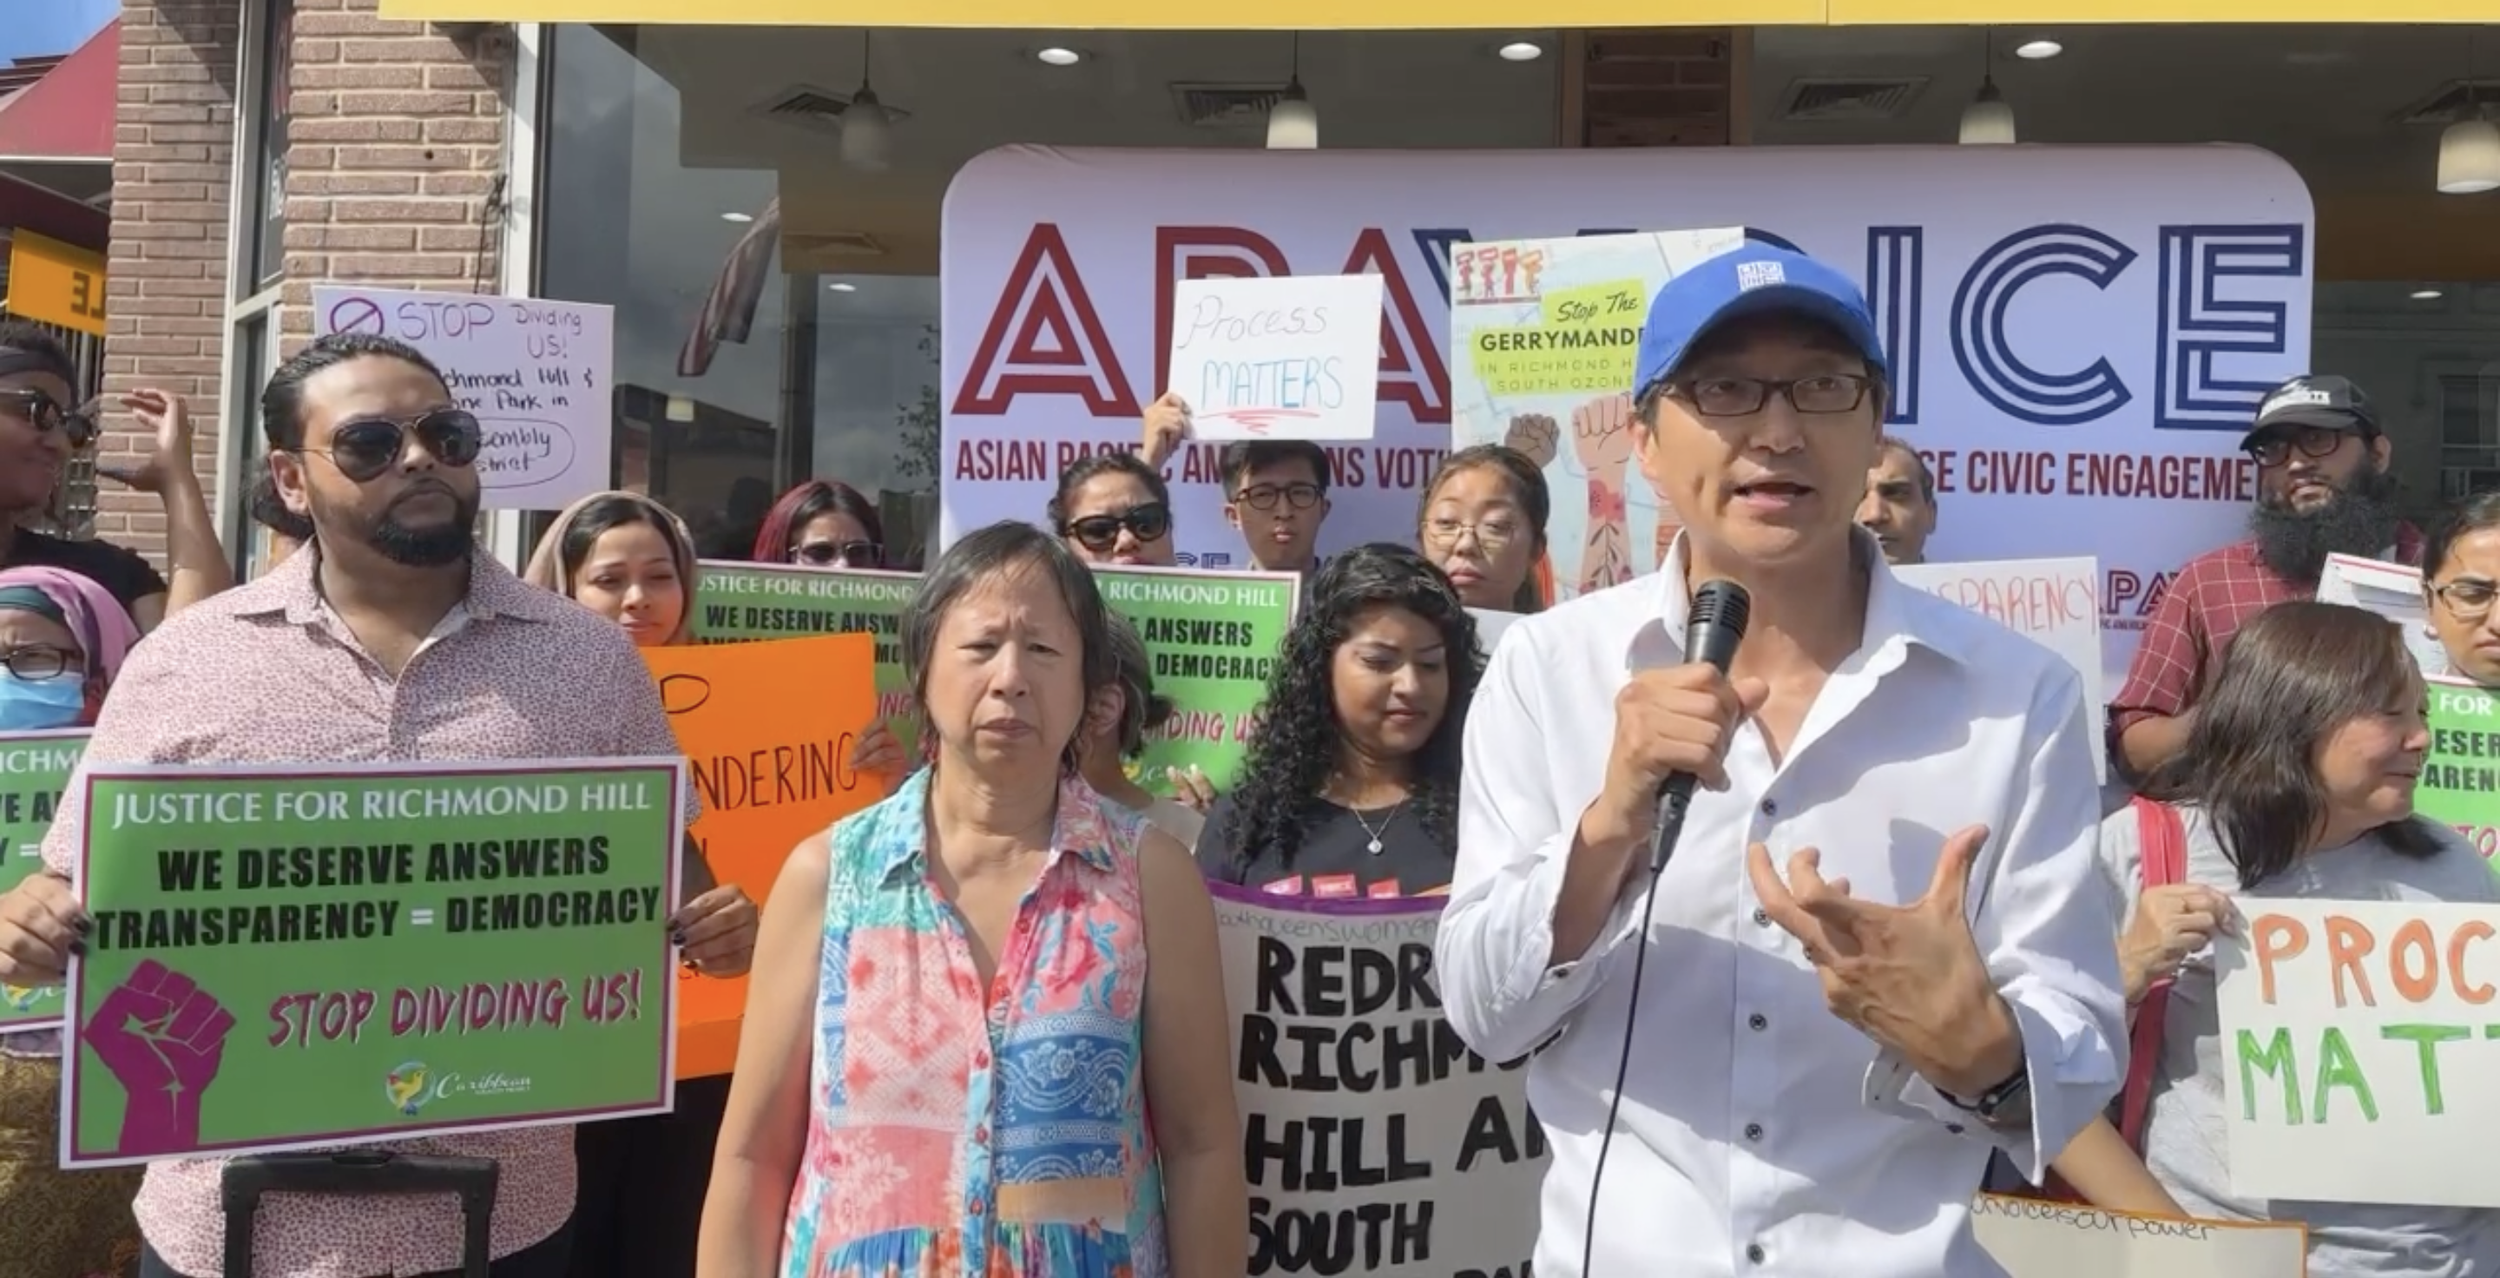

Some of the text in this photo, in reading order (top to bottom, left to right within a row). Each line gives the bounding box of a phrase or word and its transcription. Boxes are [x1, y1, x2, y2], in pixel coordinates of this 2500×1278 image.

[397, 301, 581, 341] STOP Dividing
[1176, 294, 1327, 349] Process
[1556, 290, 1638, 323] Stop The
[527, 333, 568, 360] US!
[1480, 327, 1644, 350] GERRYMAND
[442, 368, 523, 389] chmond
[1201, 355, 1342, 409] MATTERS
[1509, 359, 1610, 373] RICHMOND
[496, 389, 542, 410] Park
[552, 397, 568, 406] in
[1498, 379, 1559, 391] SOUTH
[956, 440, 1046, 481] ASIAN
[1966, 451, 2056, 495] CIVIC
[765, 578, 803, 595] FOR
[1109, 582, 1229, 605] RICHMOND
[1236, 588, 1278, 607] HILL
[706, 605, 739, 628] WE
[746, 607, 834, 632] DESERVE
[1144, 617, 1253, 648] ANSWERS
[2439, 693, 2493, 716] FOR
[112, 782, 651, 830] JUSTICE FOR RICHMOND HILL
[158, 836, 610, 891] WE DESERVE ANSWERS
[95, 900, 399, 950] TRANSPARENCY
[446, 886, 661, 933] DEMOCRACY
[268, 967, 643, 1049] STOP DIVIDING US!
[1244, 1113, 1433, 1192] HILL
[1246, 1197, 1436, 1277] SOUTH
